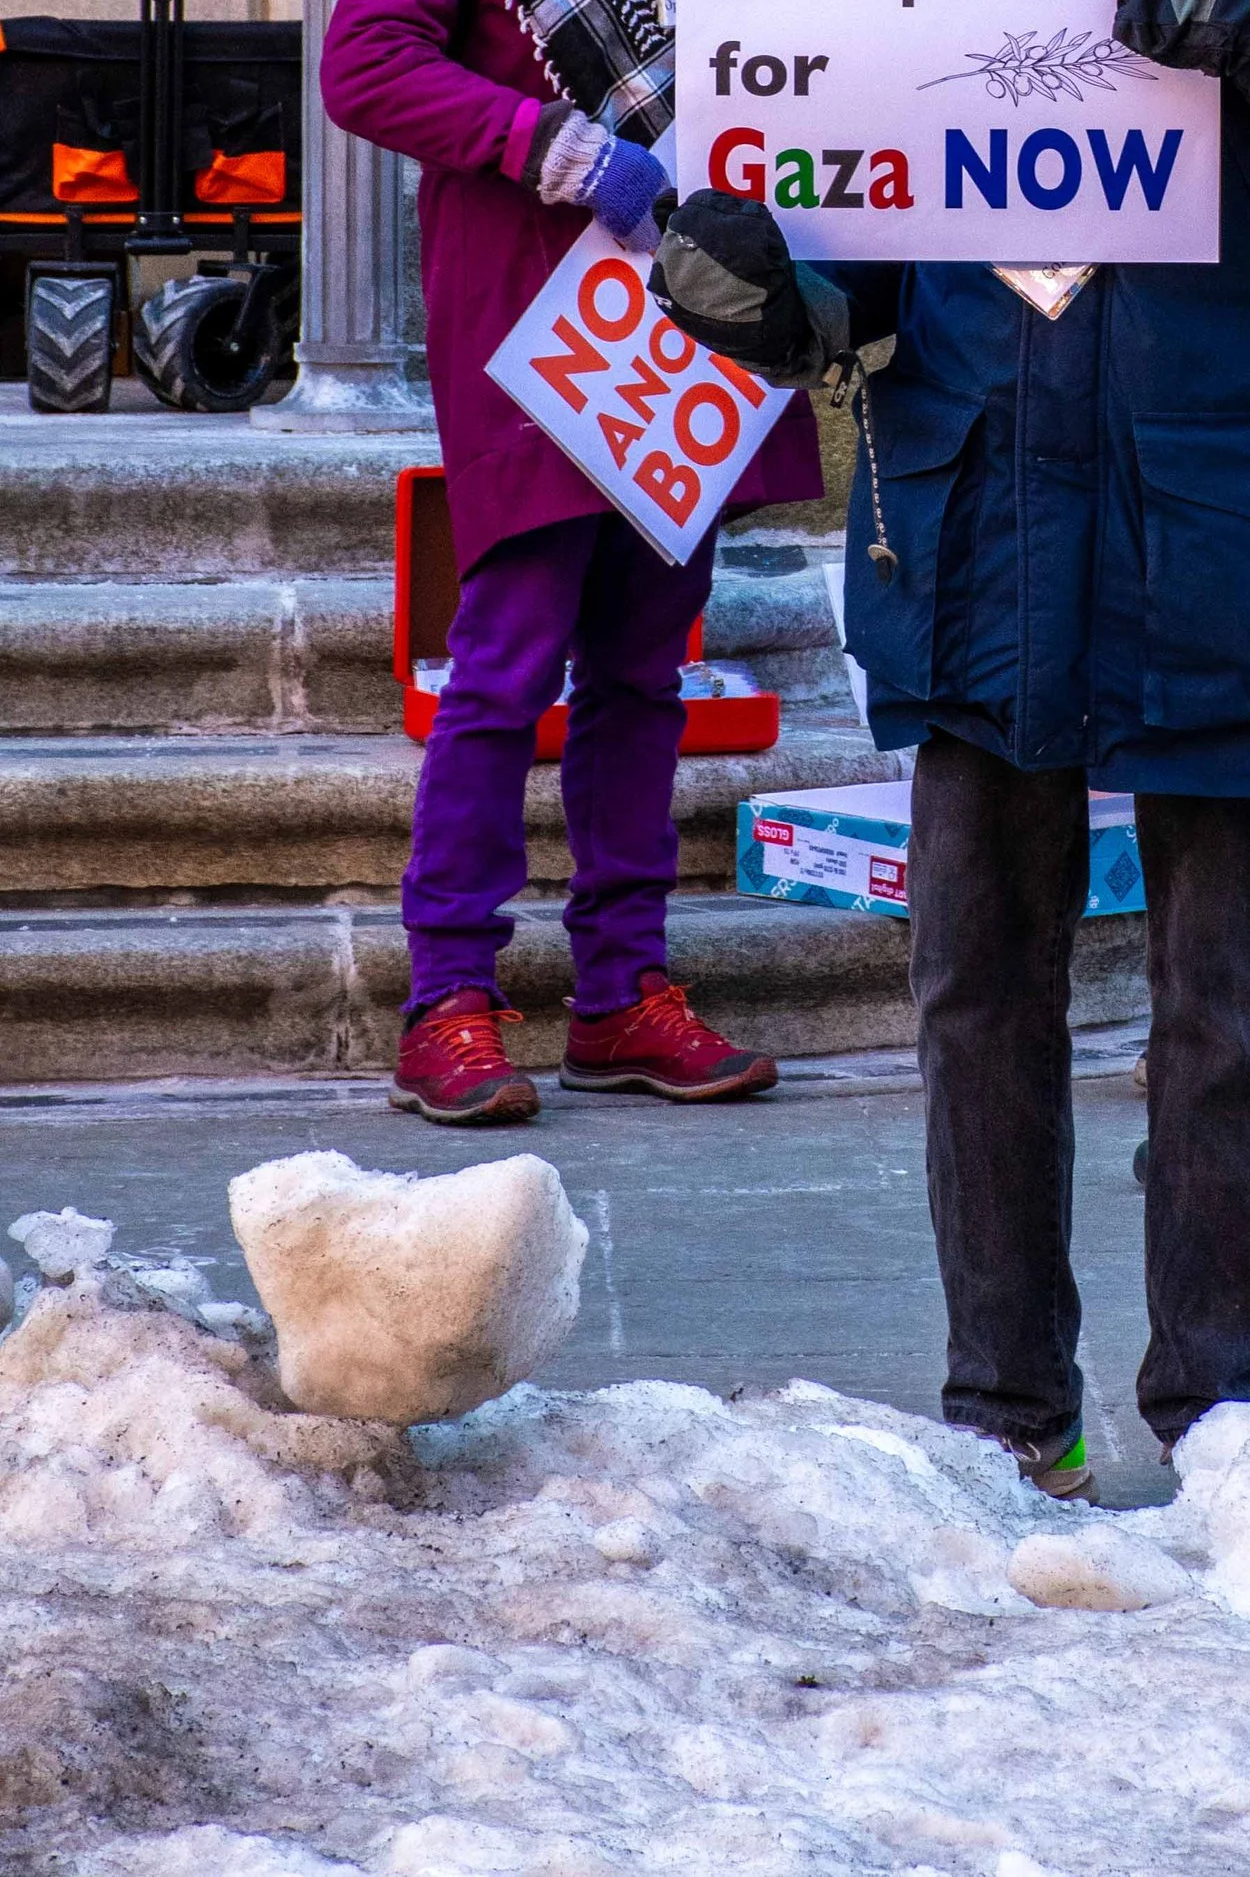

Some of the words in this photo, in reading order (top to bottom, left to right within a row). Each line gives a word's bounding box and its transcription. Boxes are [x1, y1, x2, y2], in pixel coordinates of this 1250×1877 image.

[709, 40, 829, 97] for
[708, 127, 915, 210] Gaza
[945, 128, 1184, 211] NOW
[529, 252, 650, 416] NO
[596, 317, 697, 471] ANO
[757, 823, 790, 841] GLOSS
